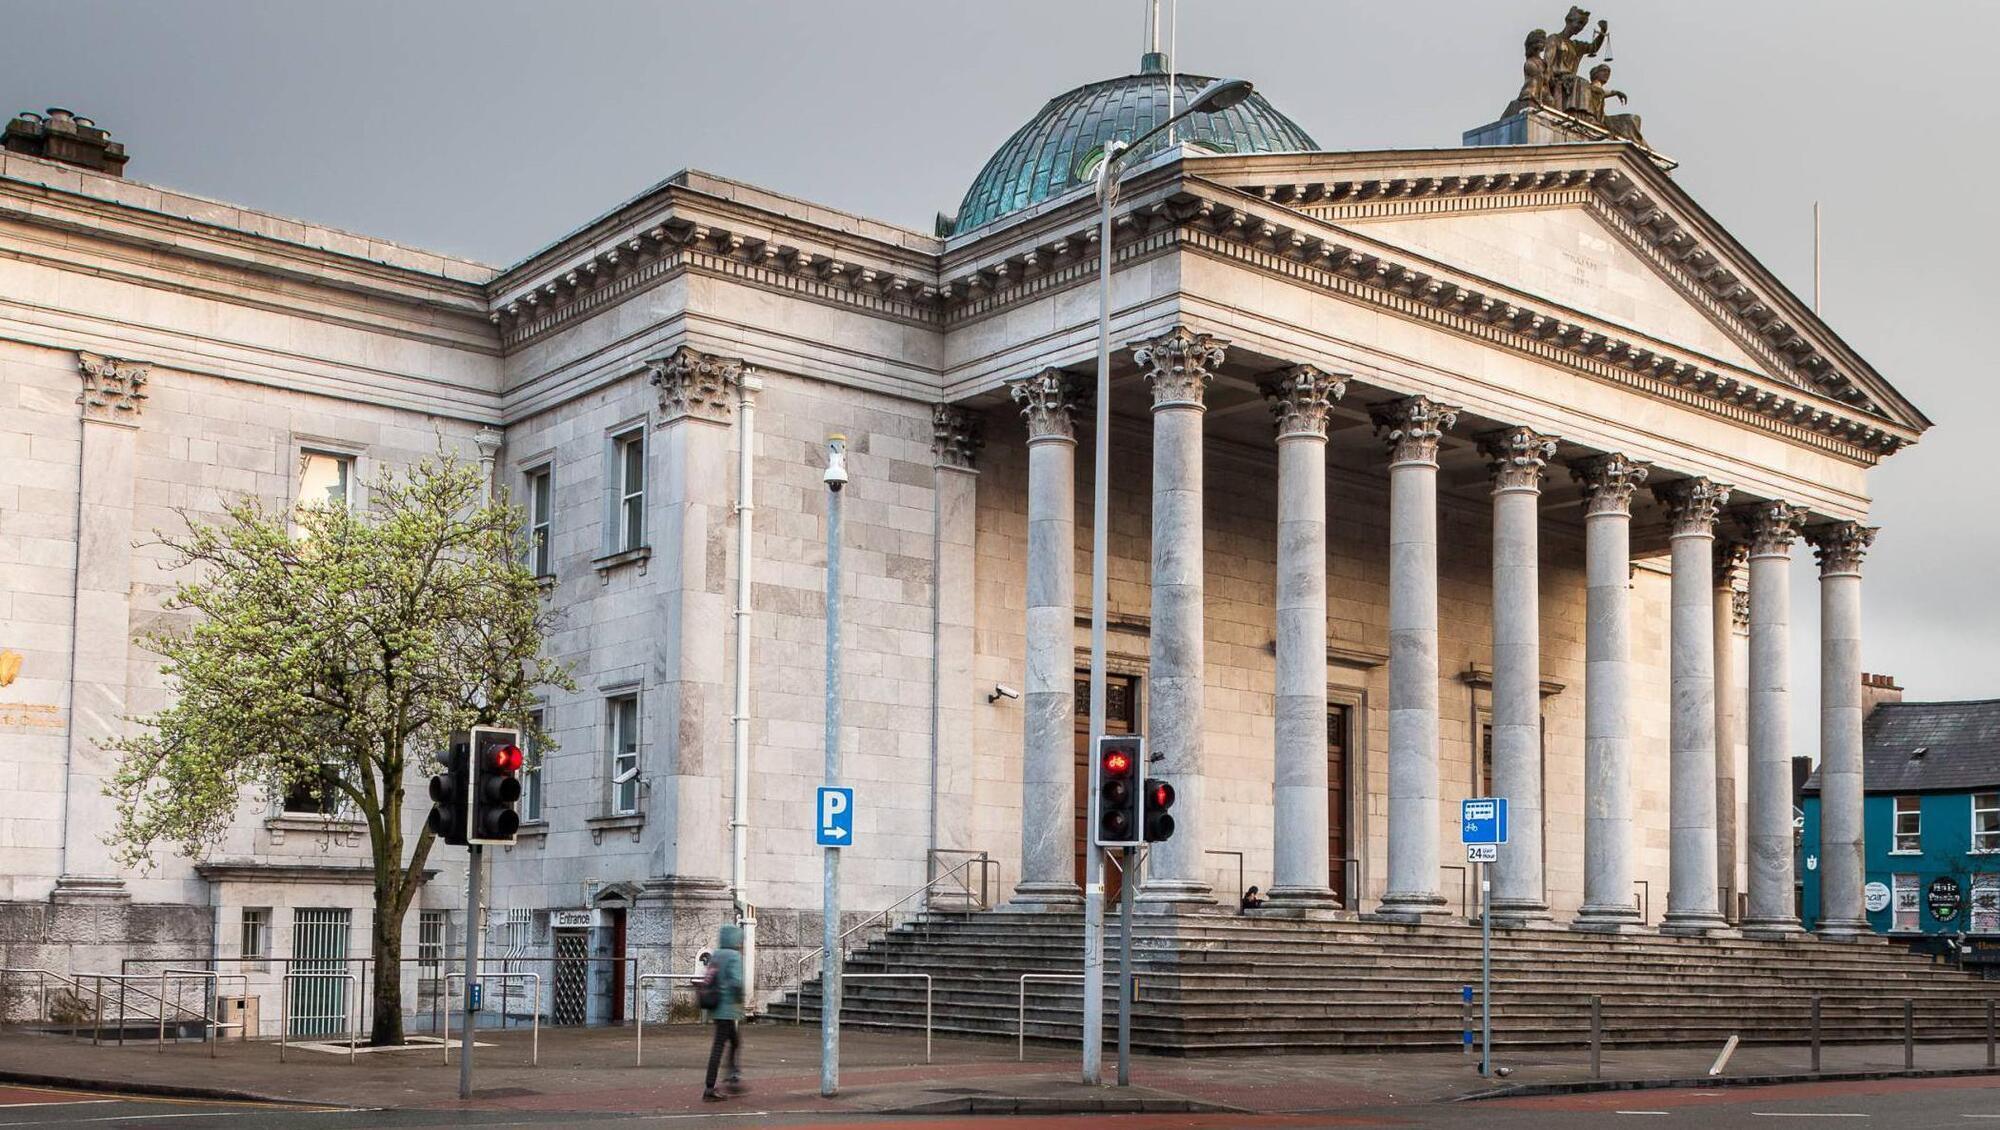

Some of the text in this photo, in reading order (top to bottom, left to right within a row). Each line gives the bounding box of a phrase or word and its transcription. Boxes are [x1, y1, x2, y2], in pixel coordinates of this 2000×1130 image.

[823, 791, 847, 828] P
[1469, 848, 1482, 859] 24
[560, 912, 590, 925] Entrance
